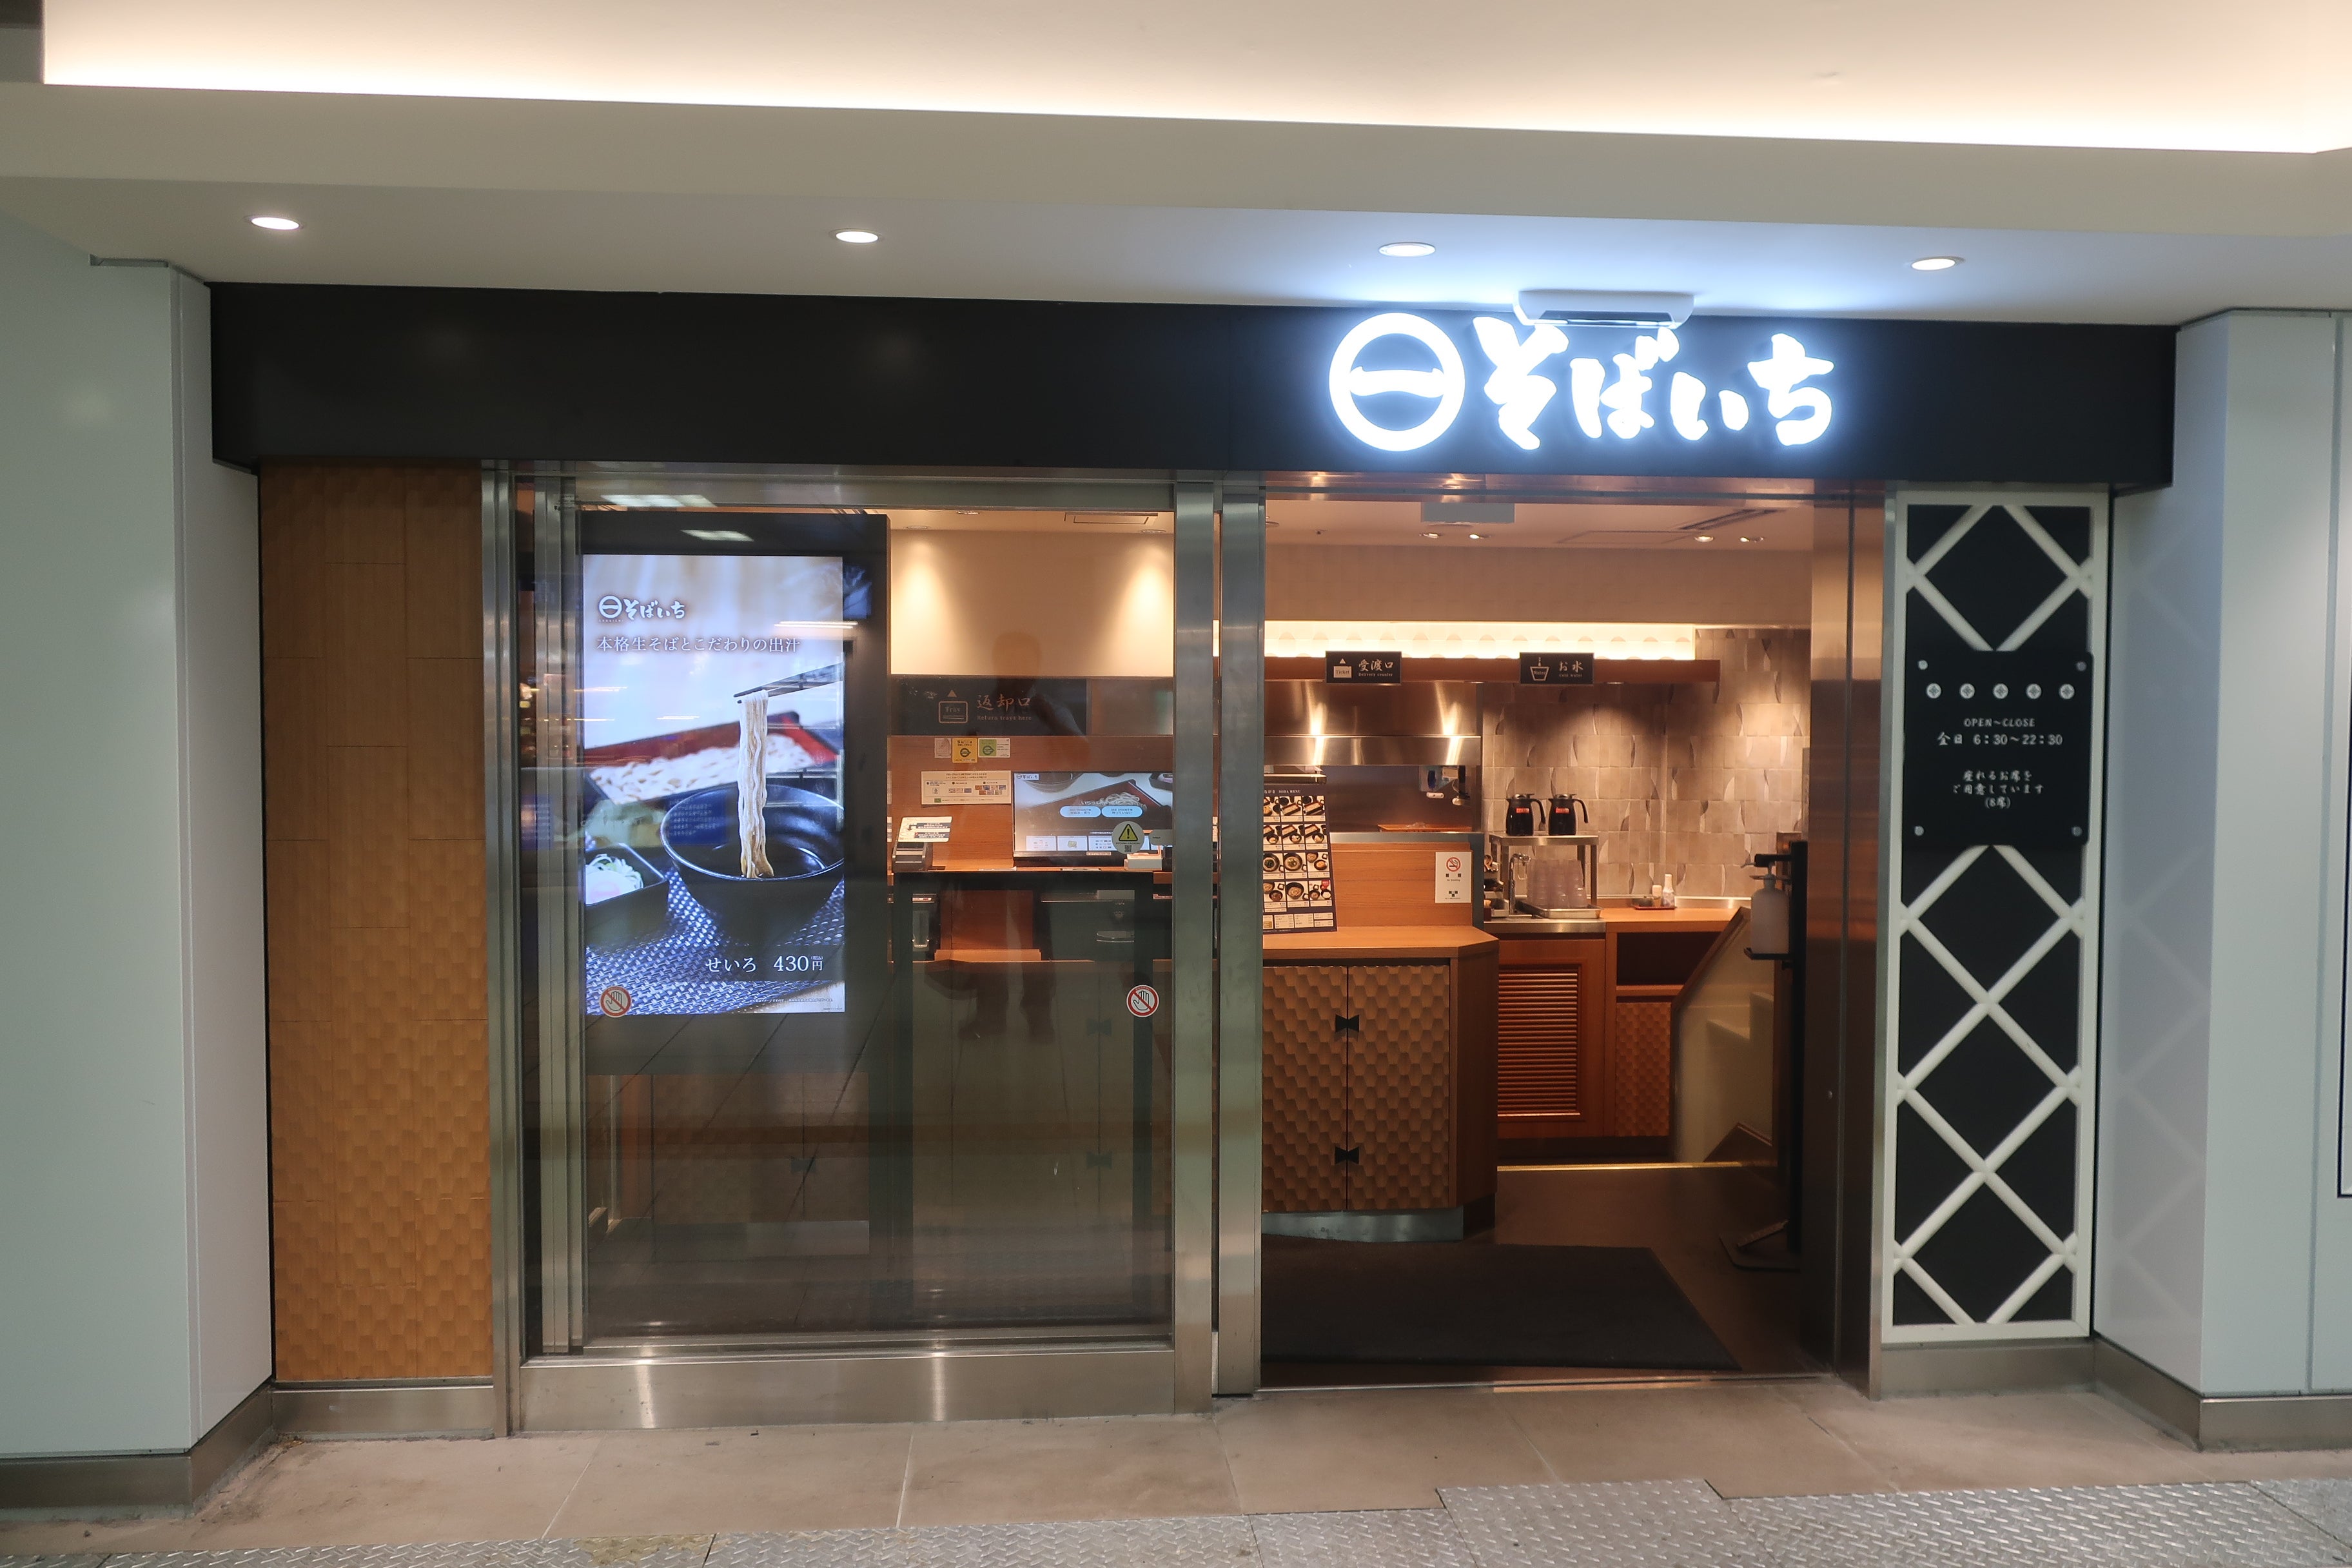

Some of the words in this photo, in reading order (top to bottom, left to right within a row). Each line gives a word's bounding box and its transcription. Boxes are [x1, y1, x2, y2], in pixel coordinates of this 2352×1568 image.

[1473, 316, 1834, 451] そばいち
[623, 598, 685, 620] そばいち
[596, 636, 801, 653] 本格生そばとこだわりの出汁
[1358, 659, 1393, 672] 受渡口
[1559, 660, 1583, 673] お水
[977, 693, 1032, 711] 返却口
[1952, 783, 2044, 795] ご用意しています
[705, 957, 757, 972] せいろ
[774, 956, 823, 972] 430円
